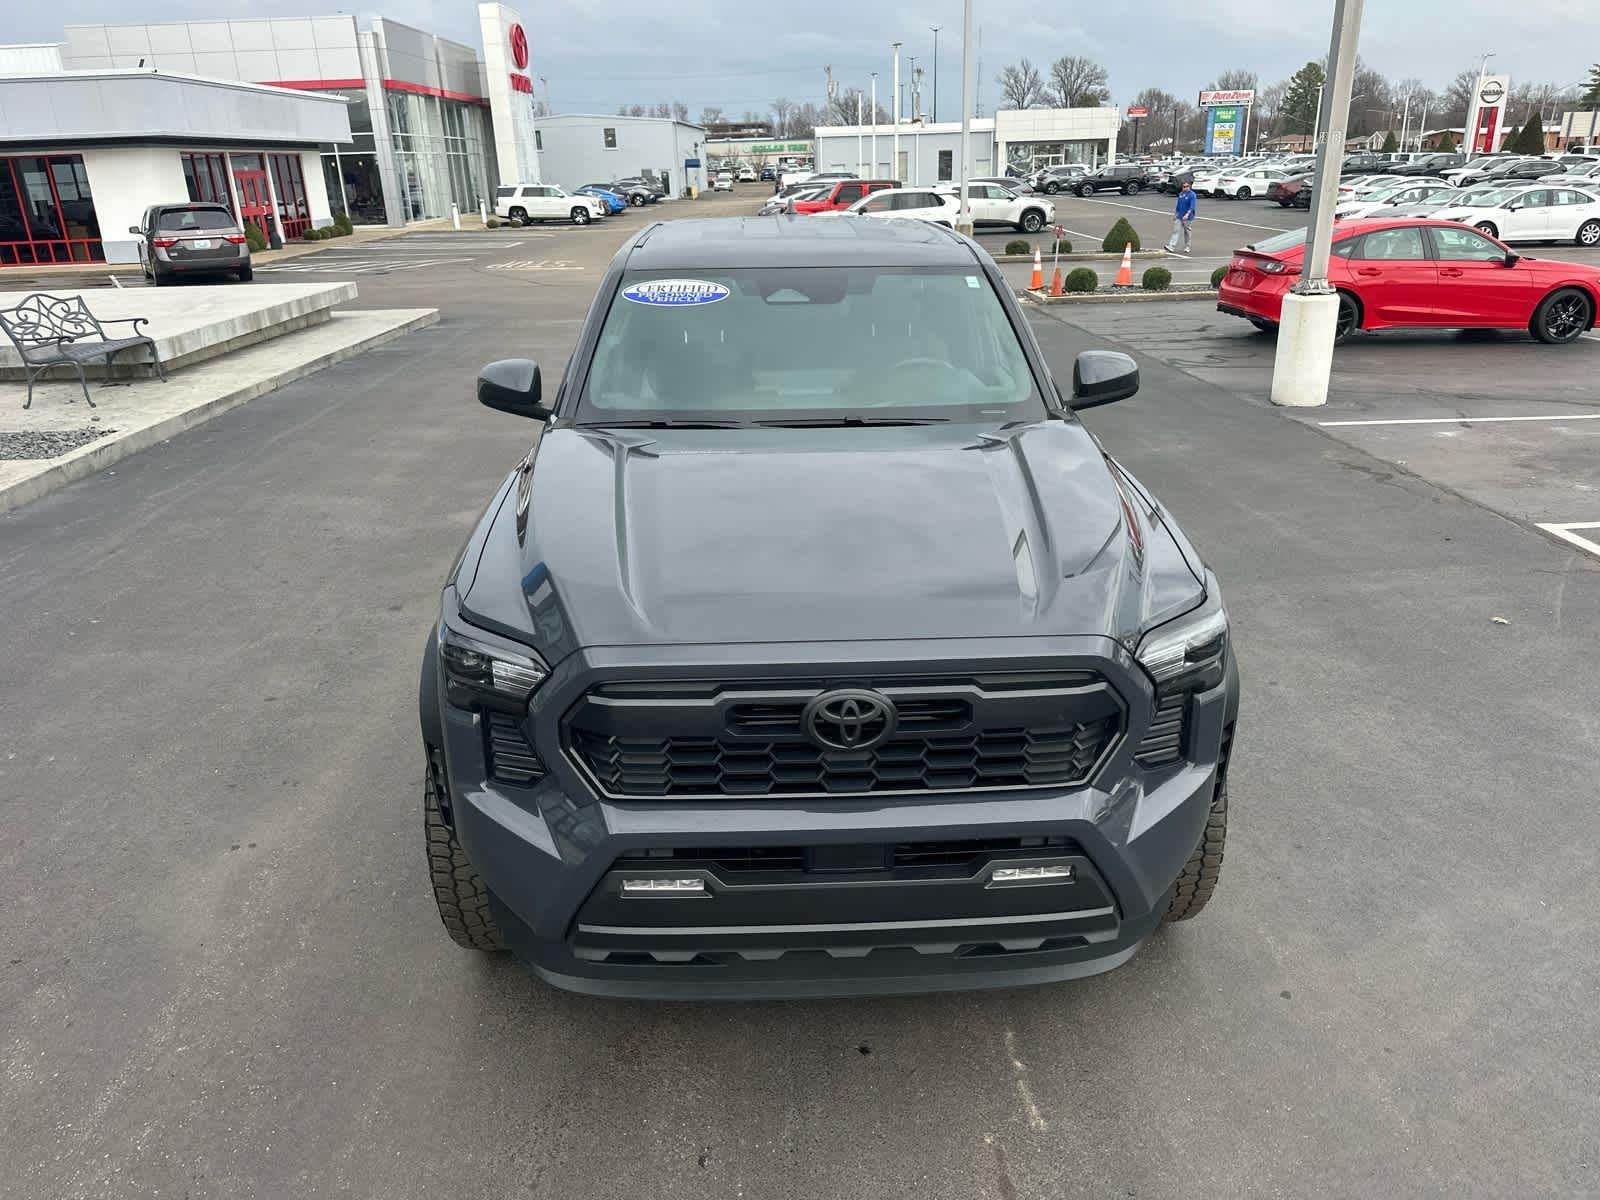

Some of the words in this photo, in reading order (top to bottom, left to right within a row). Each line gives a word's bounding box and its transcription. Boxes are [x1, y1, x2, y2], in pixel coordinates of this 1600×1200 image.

[1212, 91, 1250, 100] AutoZone
[752, 144, 784, 152] DOLLAR
[636, 284, 718, 293] CERTIFIED
